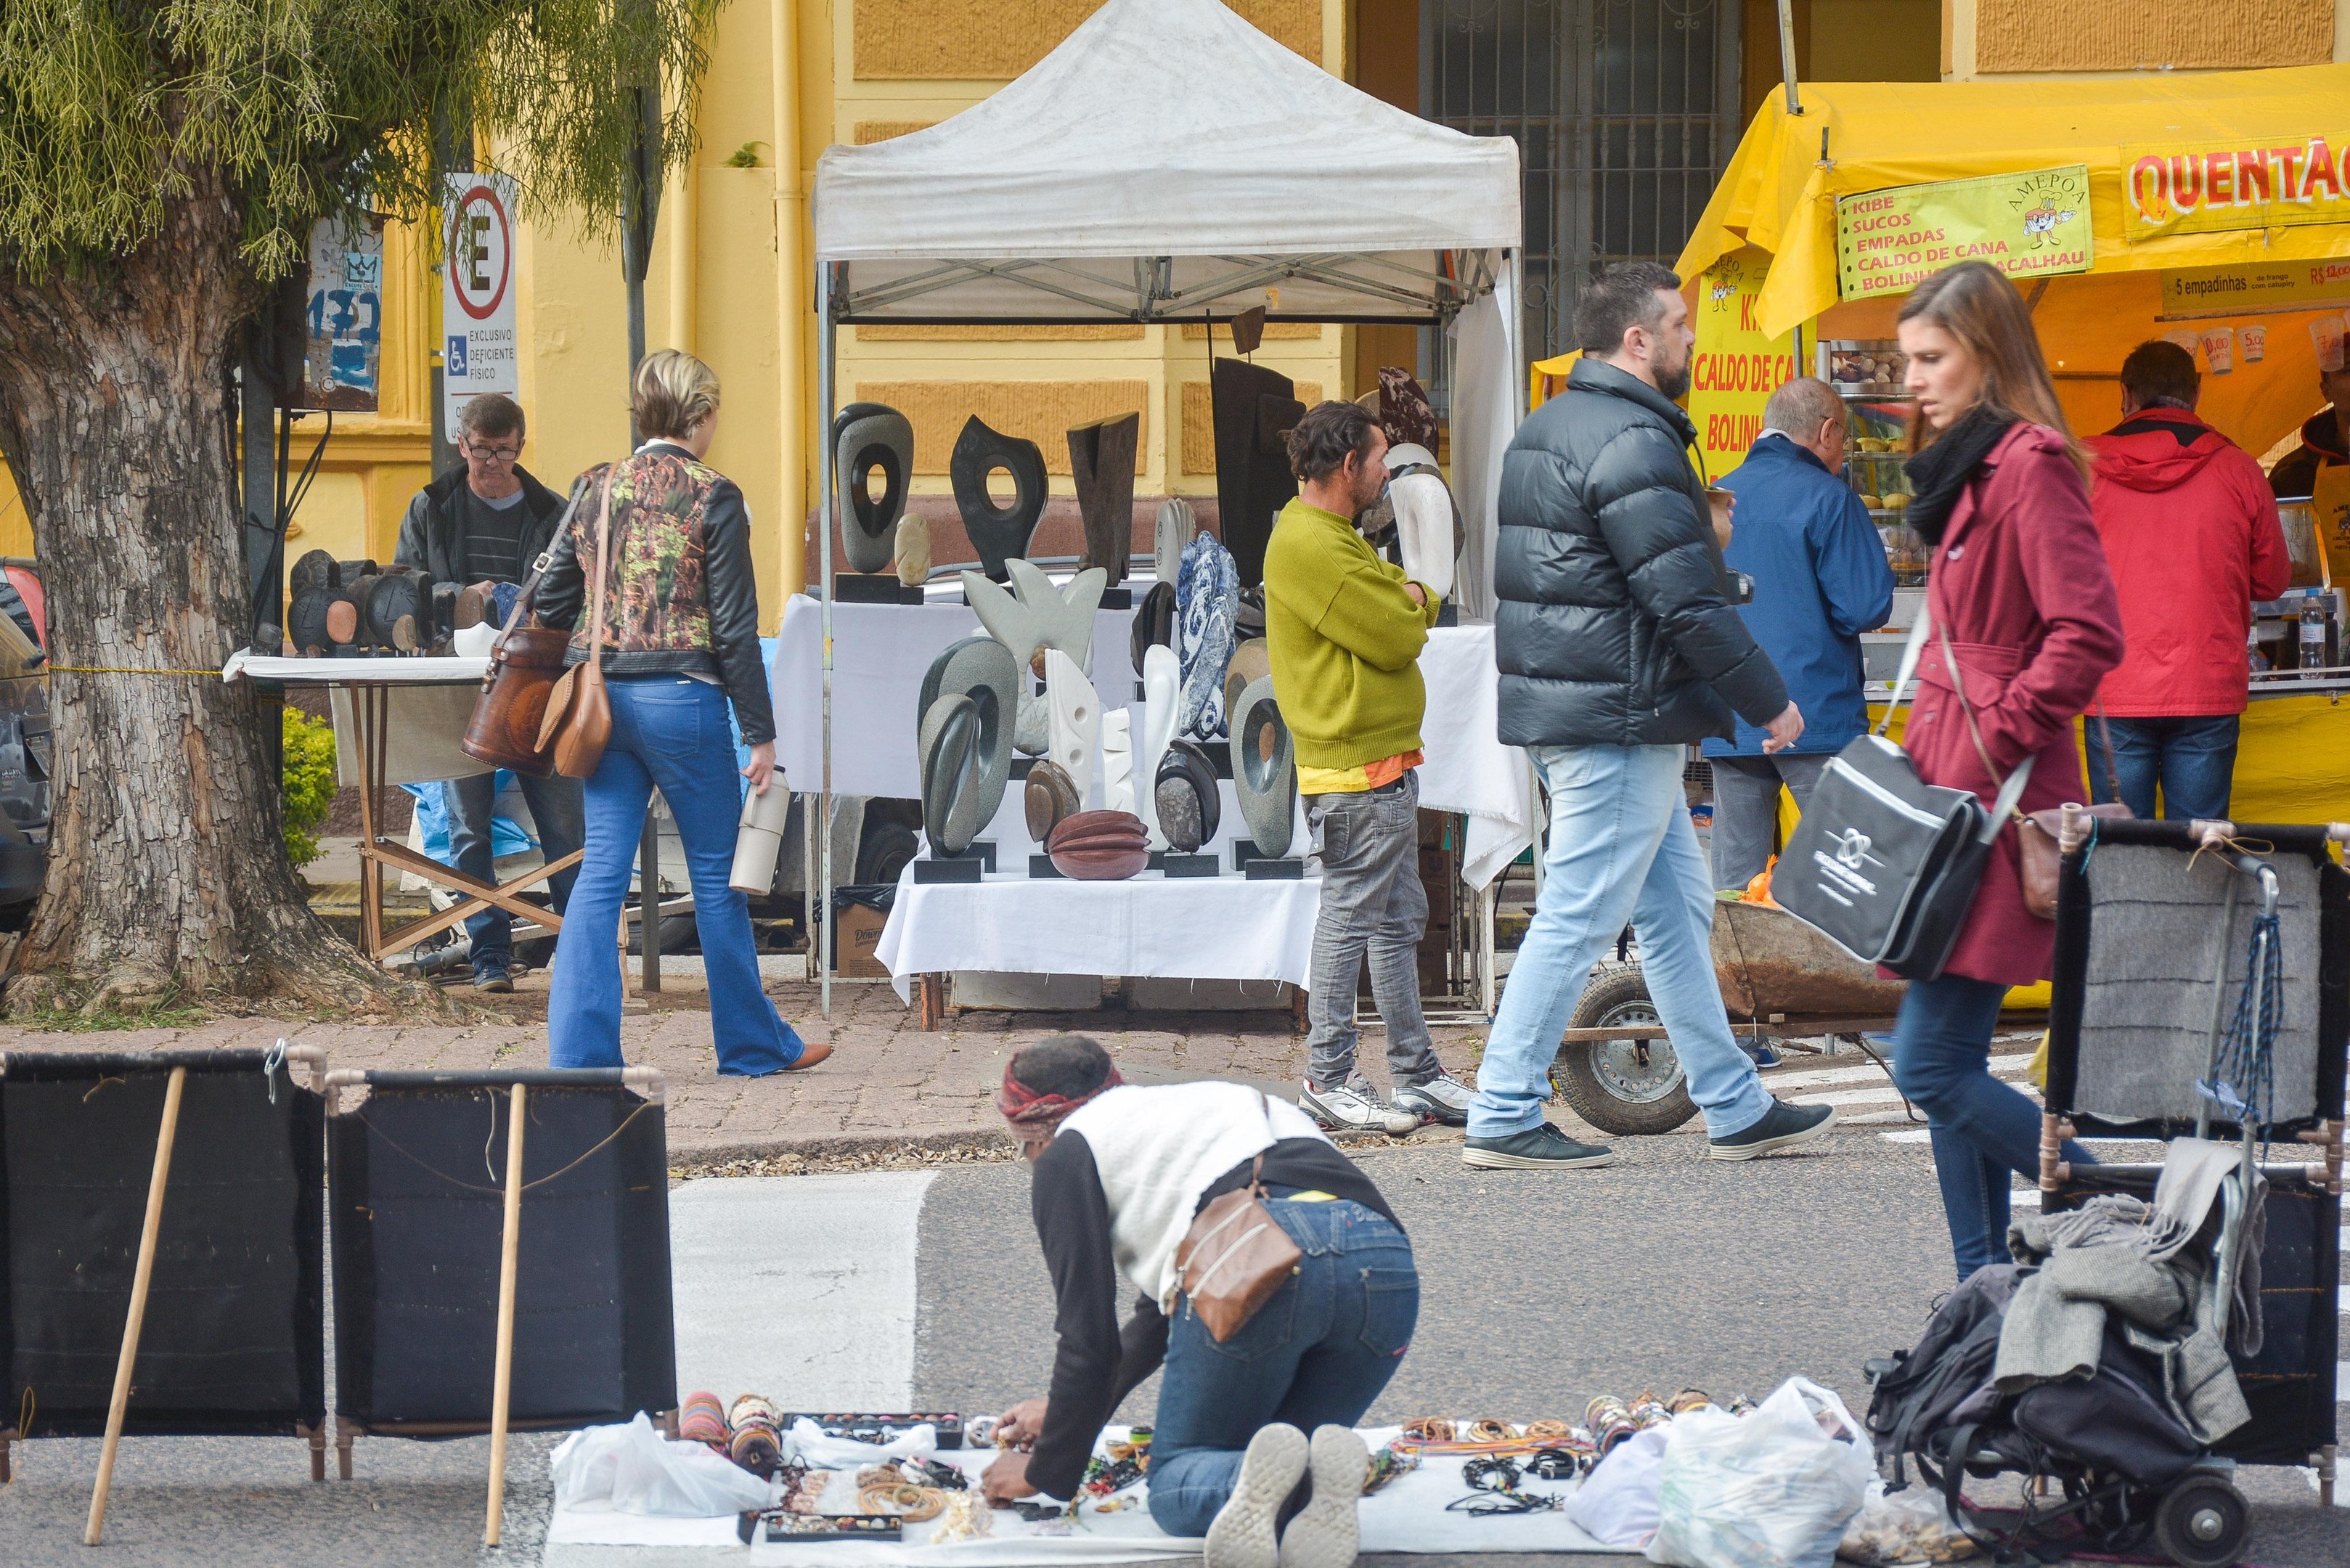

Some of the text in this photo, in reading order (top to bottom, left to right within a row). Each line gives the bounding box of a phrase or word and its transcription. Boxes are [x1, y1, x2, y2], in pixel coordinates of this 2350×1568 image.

[2009, 173, 2086, 212] AMEPOA
[1853, 196, 1895, 215] KIBE
[1853, 213, 1912, 234] SUCOS
[1857, 228, 1946, 253] EMPADAS
[470, 216, 490, 290] E
[1858, 240, 2009, 271] CALDO DE CANA
[2176, 274, 2247, 297] 5 empadinhas
[2267, 273, 2289, 282] frango
[2268, 280, 2295, 290] catupiry
[2310, 266, 2325, 286] R$
[1740, 293, 1762, 331] KI
[470, 329, 512, 342] EXCLUSIVO
[470, 348, 514, 361] DEFICIENTE
[470, 367, 495, 380] FÍSICO
[1694, 353, 1748, 391] CALDO
[1751, 354, 1771, 392] DE
